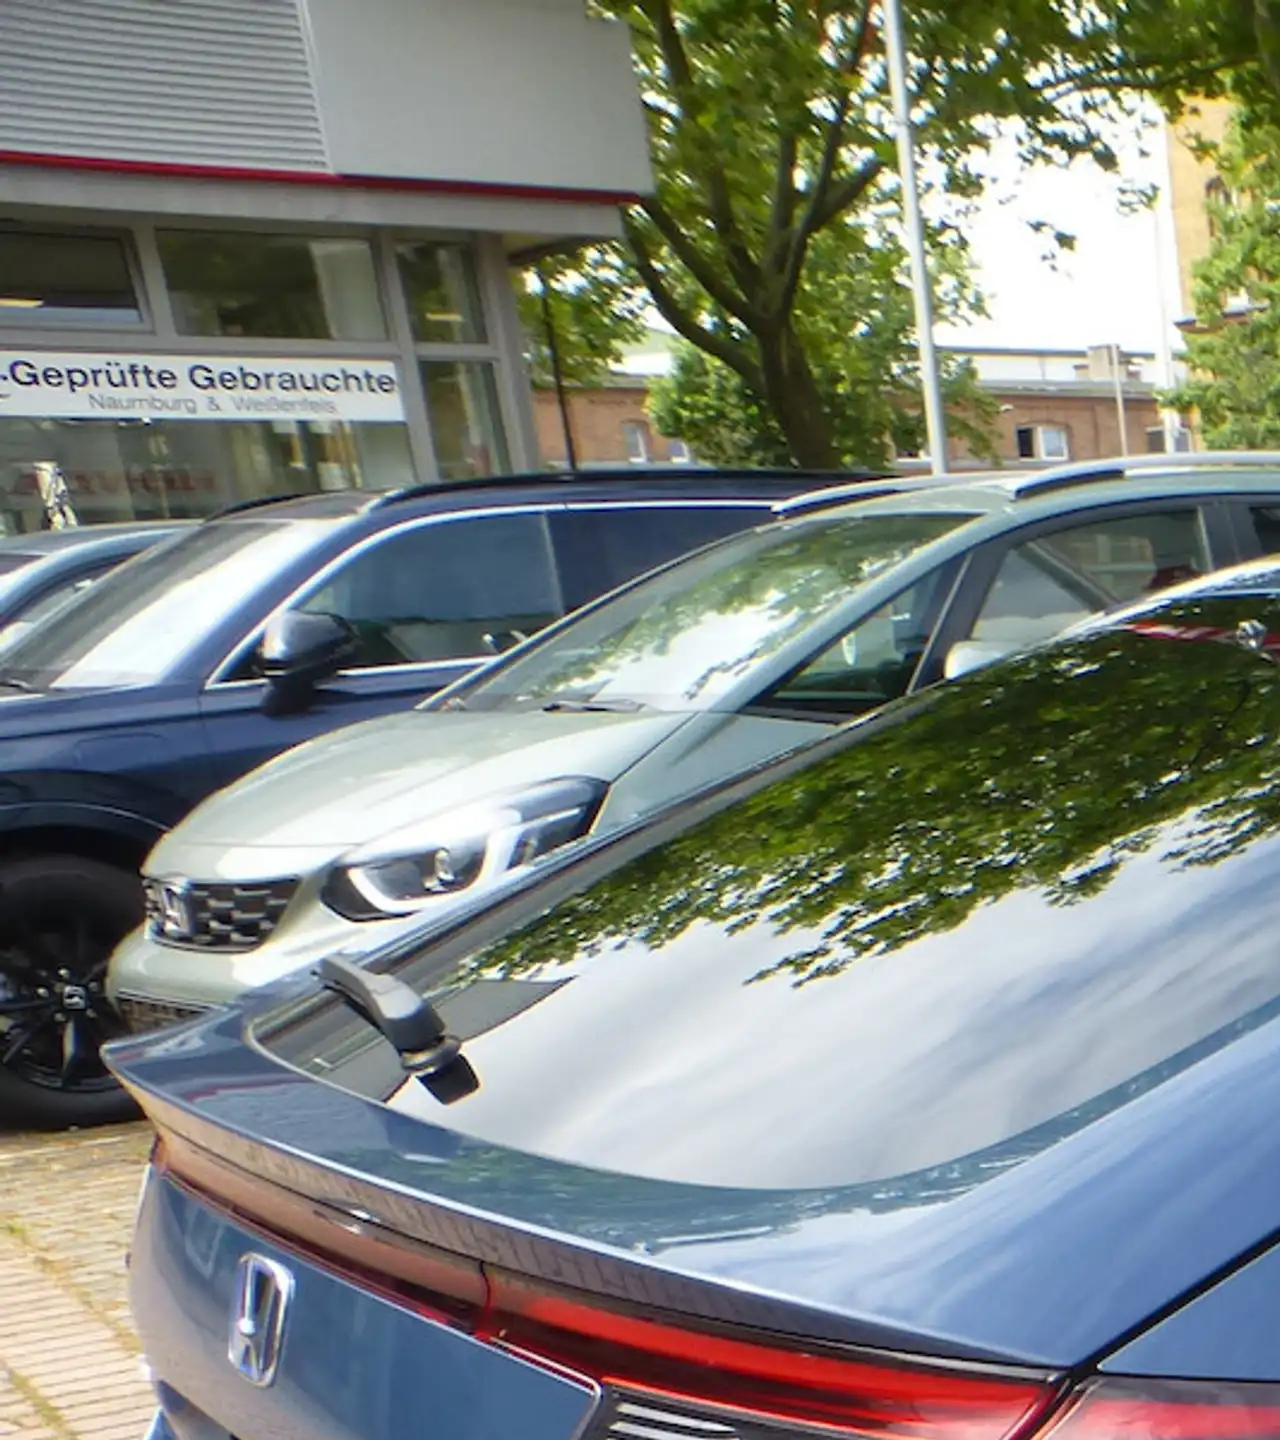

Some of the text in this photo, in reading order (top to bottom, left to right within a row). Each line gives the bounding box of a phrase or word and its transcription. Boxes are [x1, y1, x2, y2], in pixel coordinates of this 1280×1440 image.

[187, 363, 396, 394] Gebrauchte
[88, 393, 198, 414] Naumburg
[206, 397, 221, 412] &
